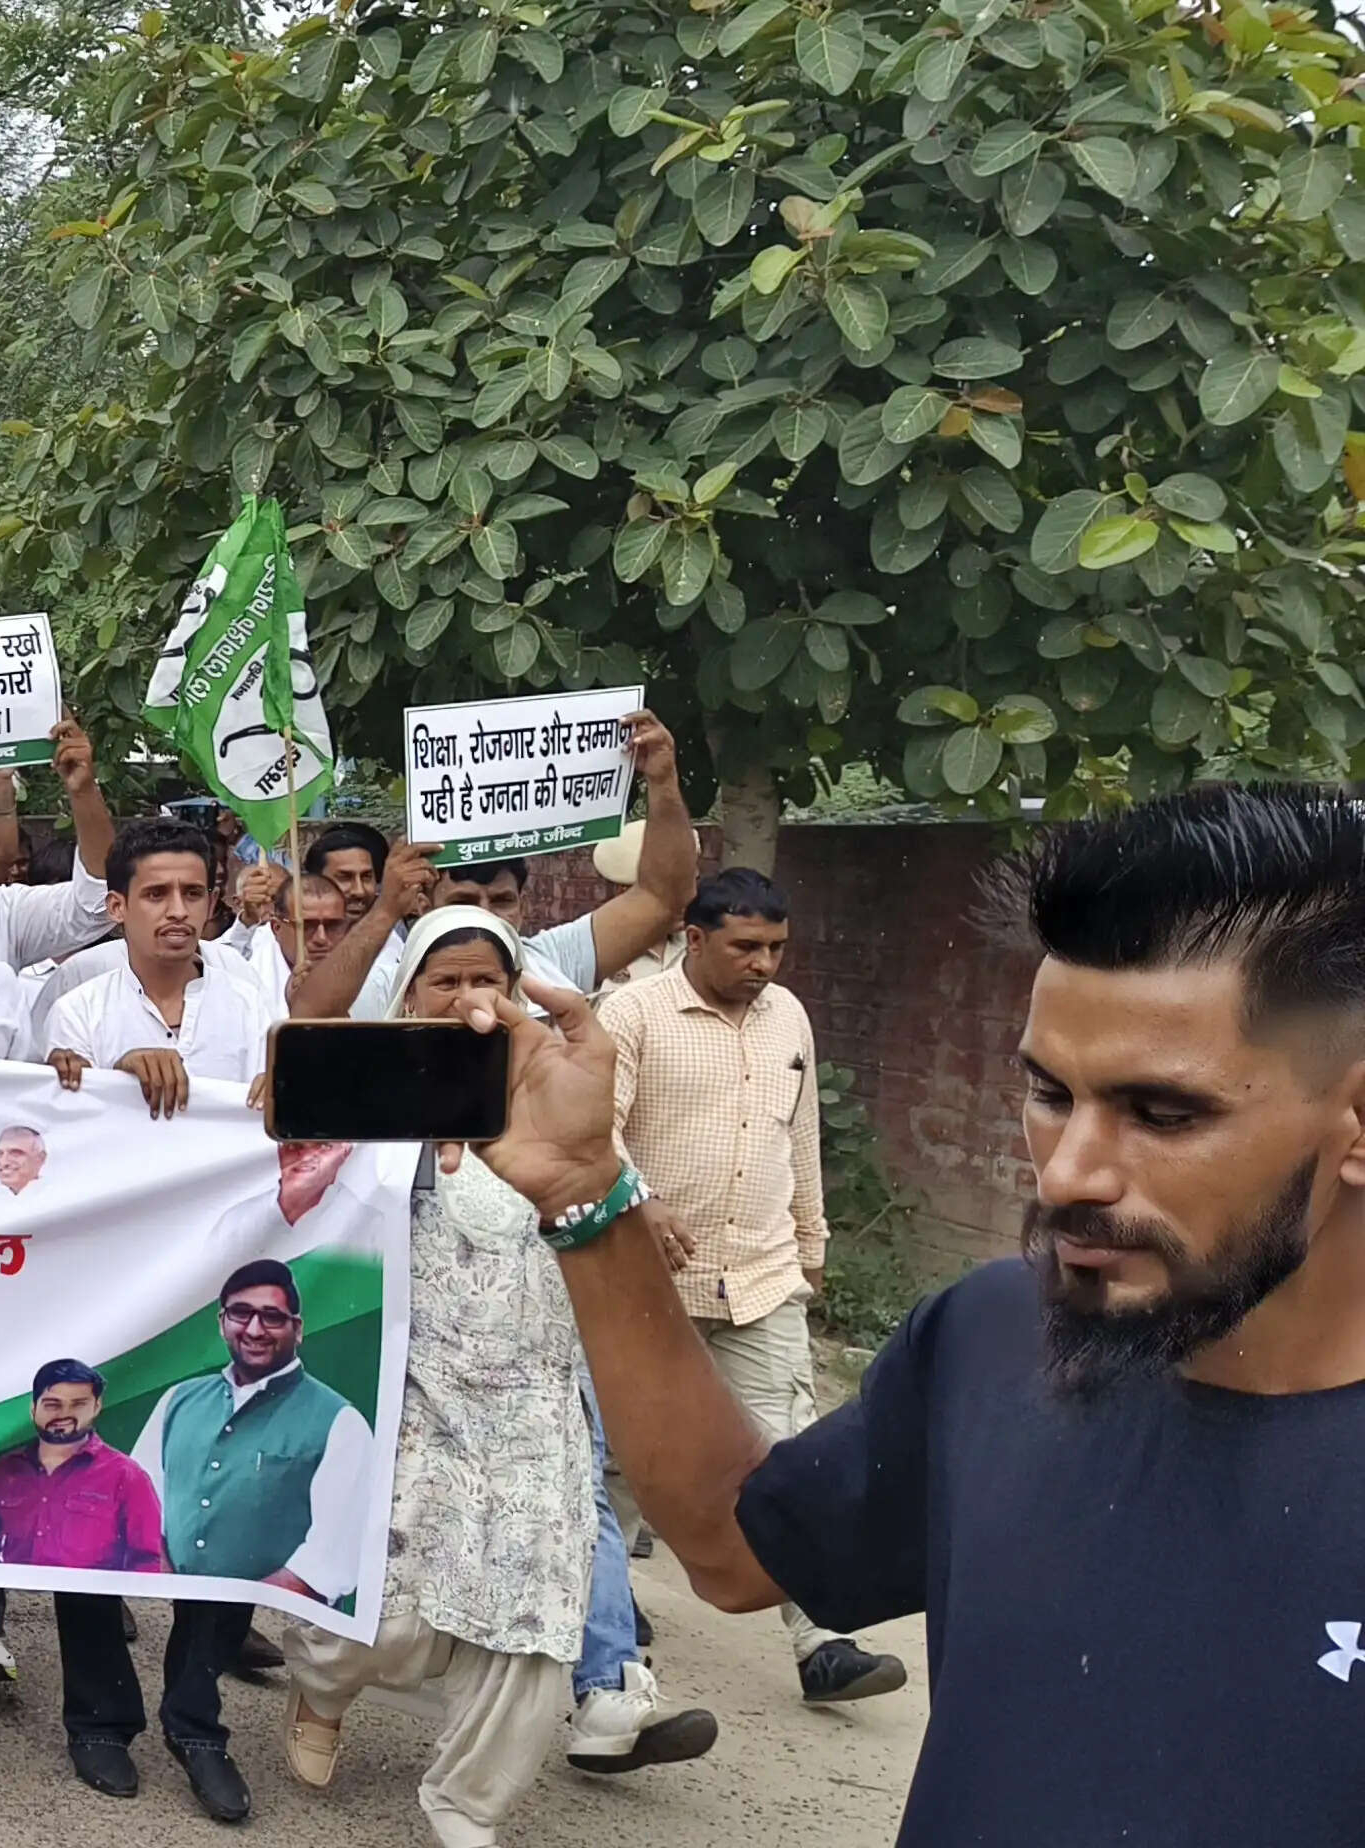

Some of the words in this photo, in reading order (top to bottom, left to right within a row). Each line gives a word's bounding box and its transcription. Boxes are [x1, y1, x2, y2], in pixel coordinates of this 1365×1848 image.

[0, 624, 42, 658] रखो
[413, 723, 463, 769] शिक्षा,
[470, 720, 536, 764] रोजगार
[539, 710, 573, 758] और
[421, 774, 454, 824] यही
[459, 772, 473, 822] है
[478, 780, 529, 815] जनता
[534, 763, 557, 809] की
[562, 764, 622, 807] पहचान।
[457, 839, 491, 861] युवा
[543, 825, 585, 843] जीन्द
